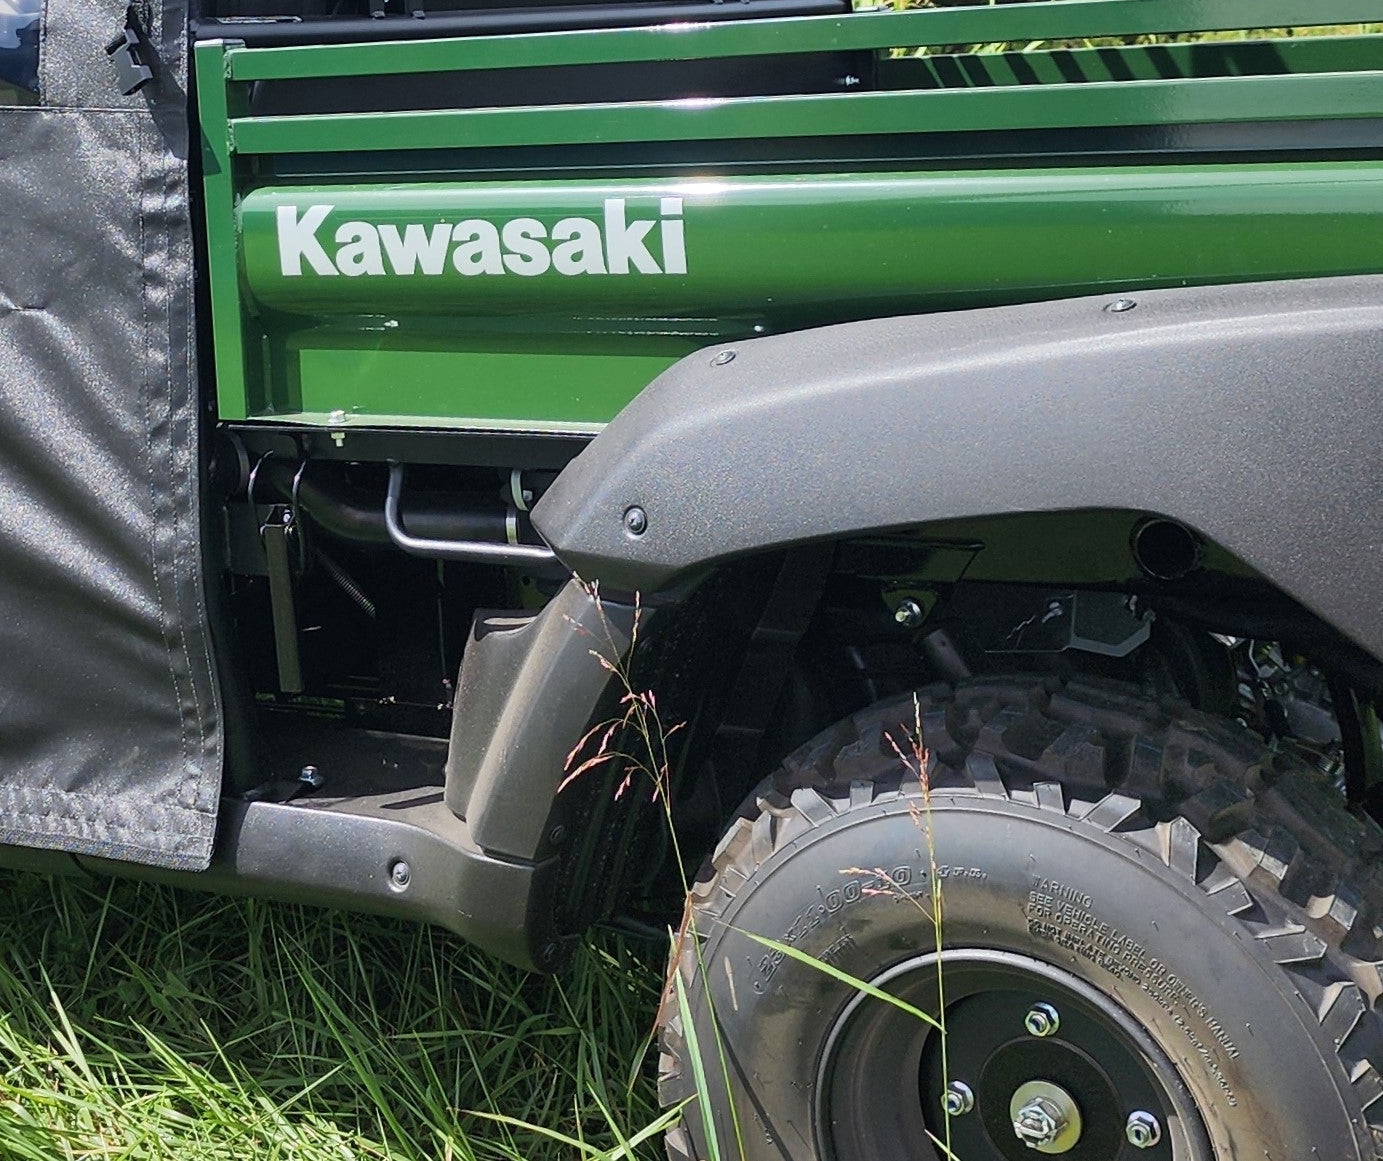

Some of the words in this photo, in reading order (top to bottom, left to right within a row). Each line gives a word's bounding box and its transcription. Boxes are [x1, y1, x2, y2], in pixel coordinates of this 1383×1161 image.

[277, 198, 687, 276] Kawasaki
[1027, 902, 1053, 919] FOR
[1055, 912, 1121, 955] OPERATING
[1029, 891, 1054, 906] SEE
[1056, 899, 1110, 936] VEHICLE
[1110, 928, 1146, 959] LABEL
[1149, 957, 1167, 977] OR
